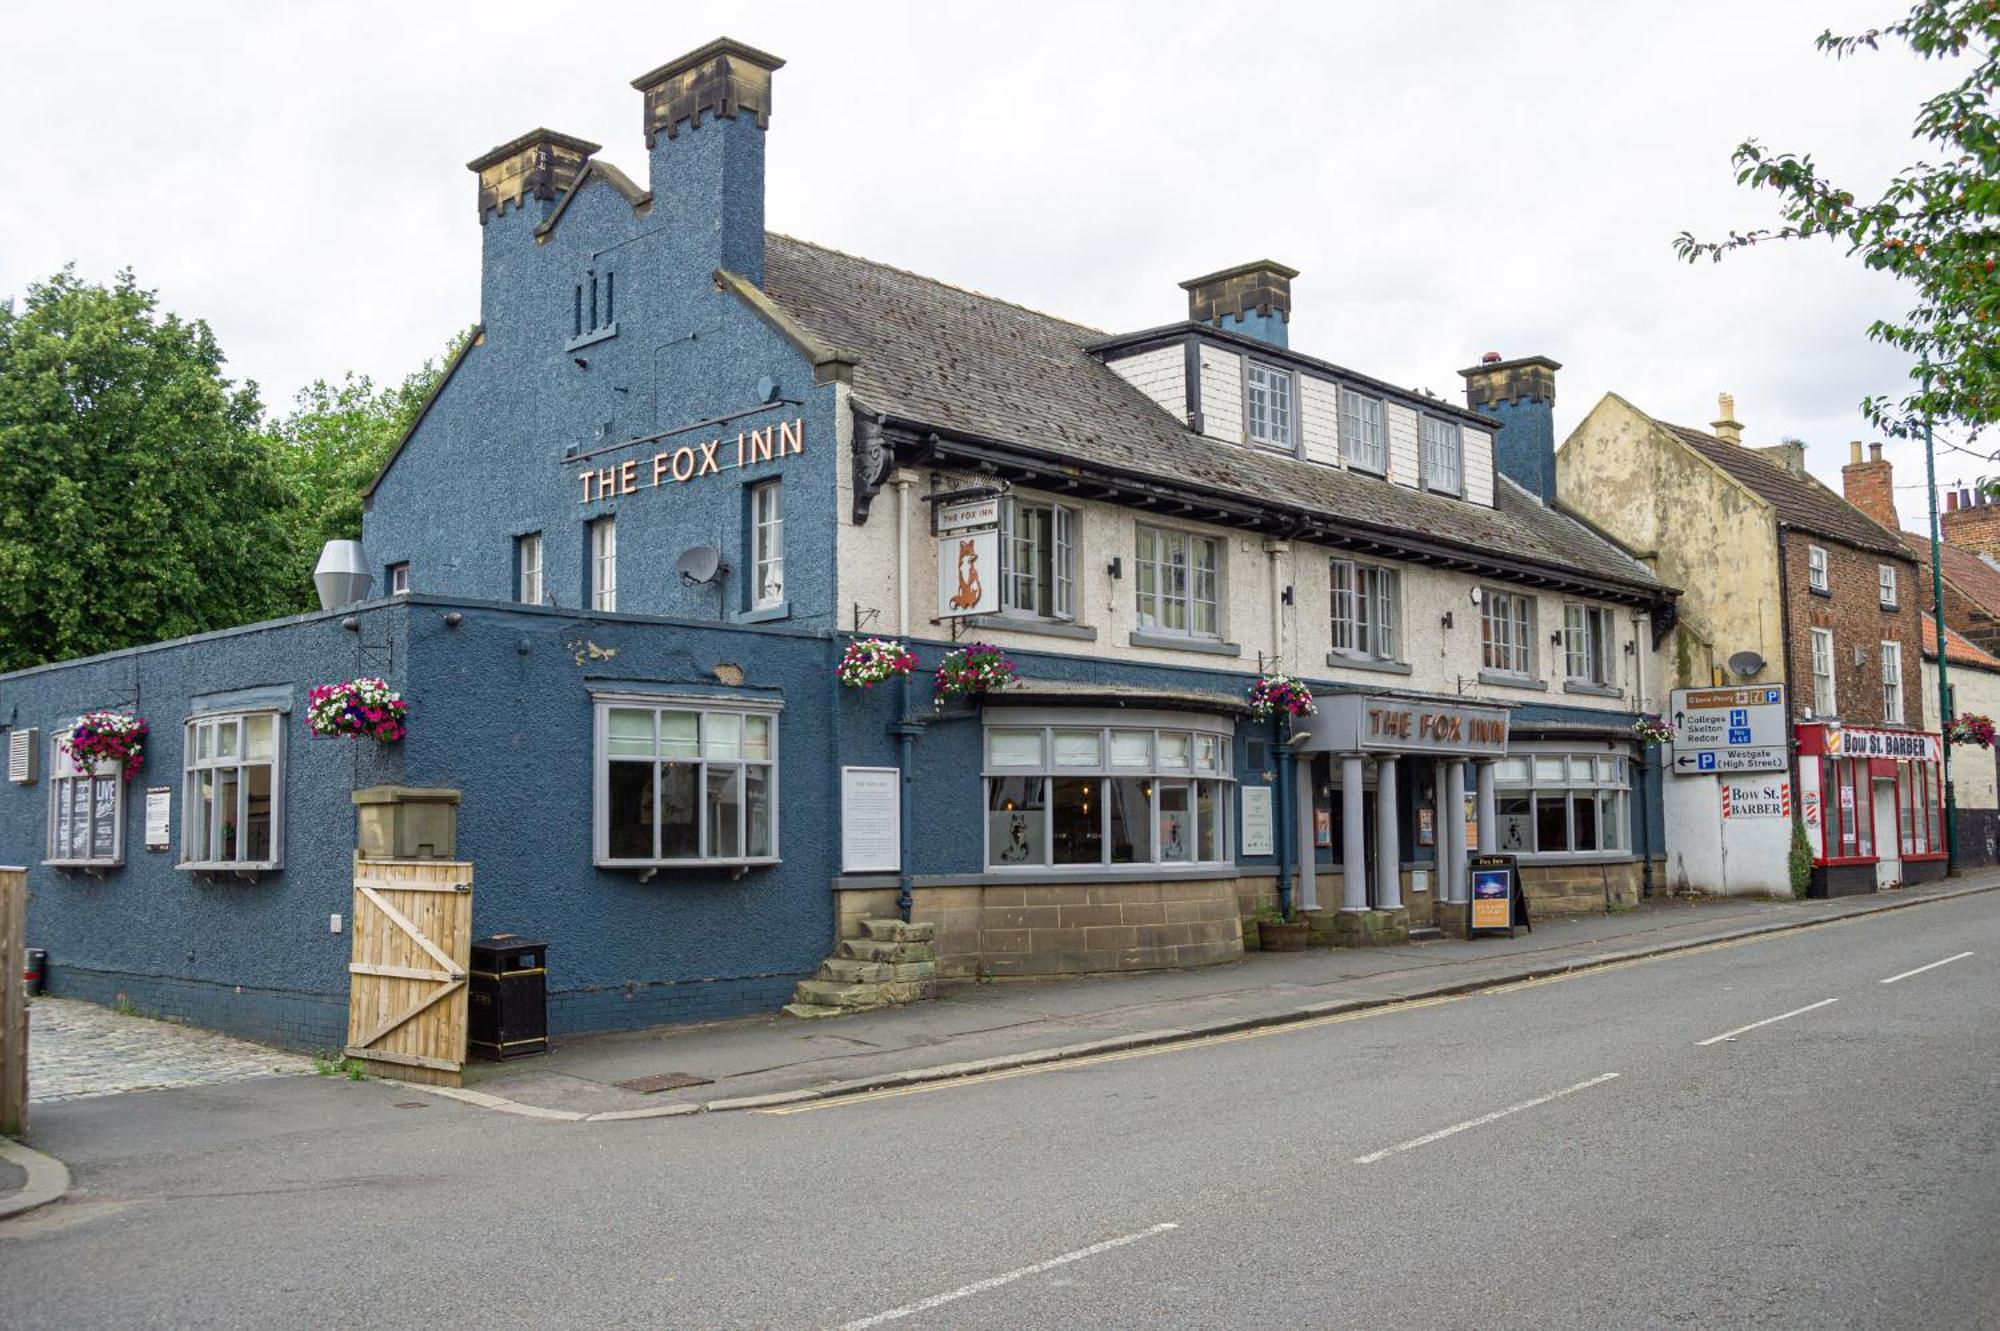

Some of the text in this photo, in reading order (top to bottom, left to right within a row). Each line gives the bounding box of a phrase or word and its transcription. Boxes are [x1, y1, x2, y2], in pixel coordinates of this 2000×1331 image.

[579, 418, 803, 503] THE FOX INN
[944, 509, 993, 523] THE FOX INN
[1370, 709, 1505, 744] THE FOX INN
[1687, 716, 1725, 725] Colleges
[1688, 725, 1723, 733] Skelton
[1844, 733, 1926, 757] Bow St. BARBER
[1717, 758, 1782, 768] (High Street)
[96, 781, 116, 801] LIVE
[1732, 786, 1779, 800] Bow St.
[1732, 804, 1781, 814] BARBER
